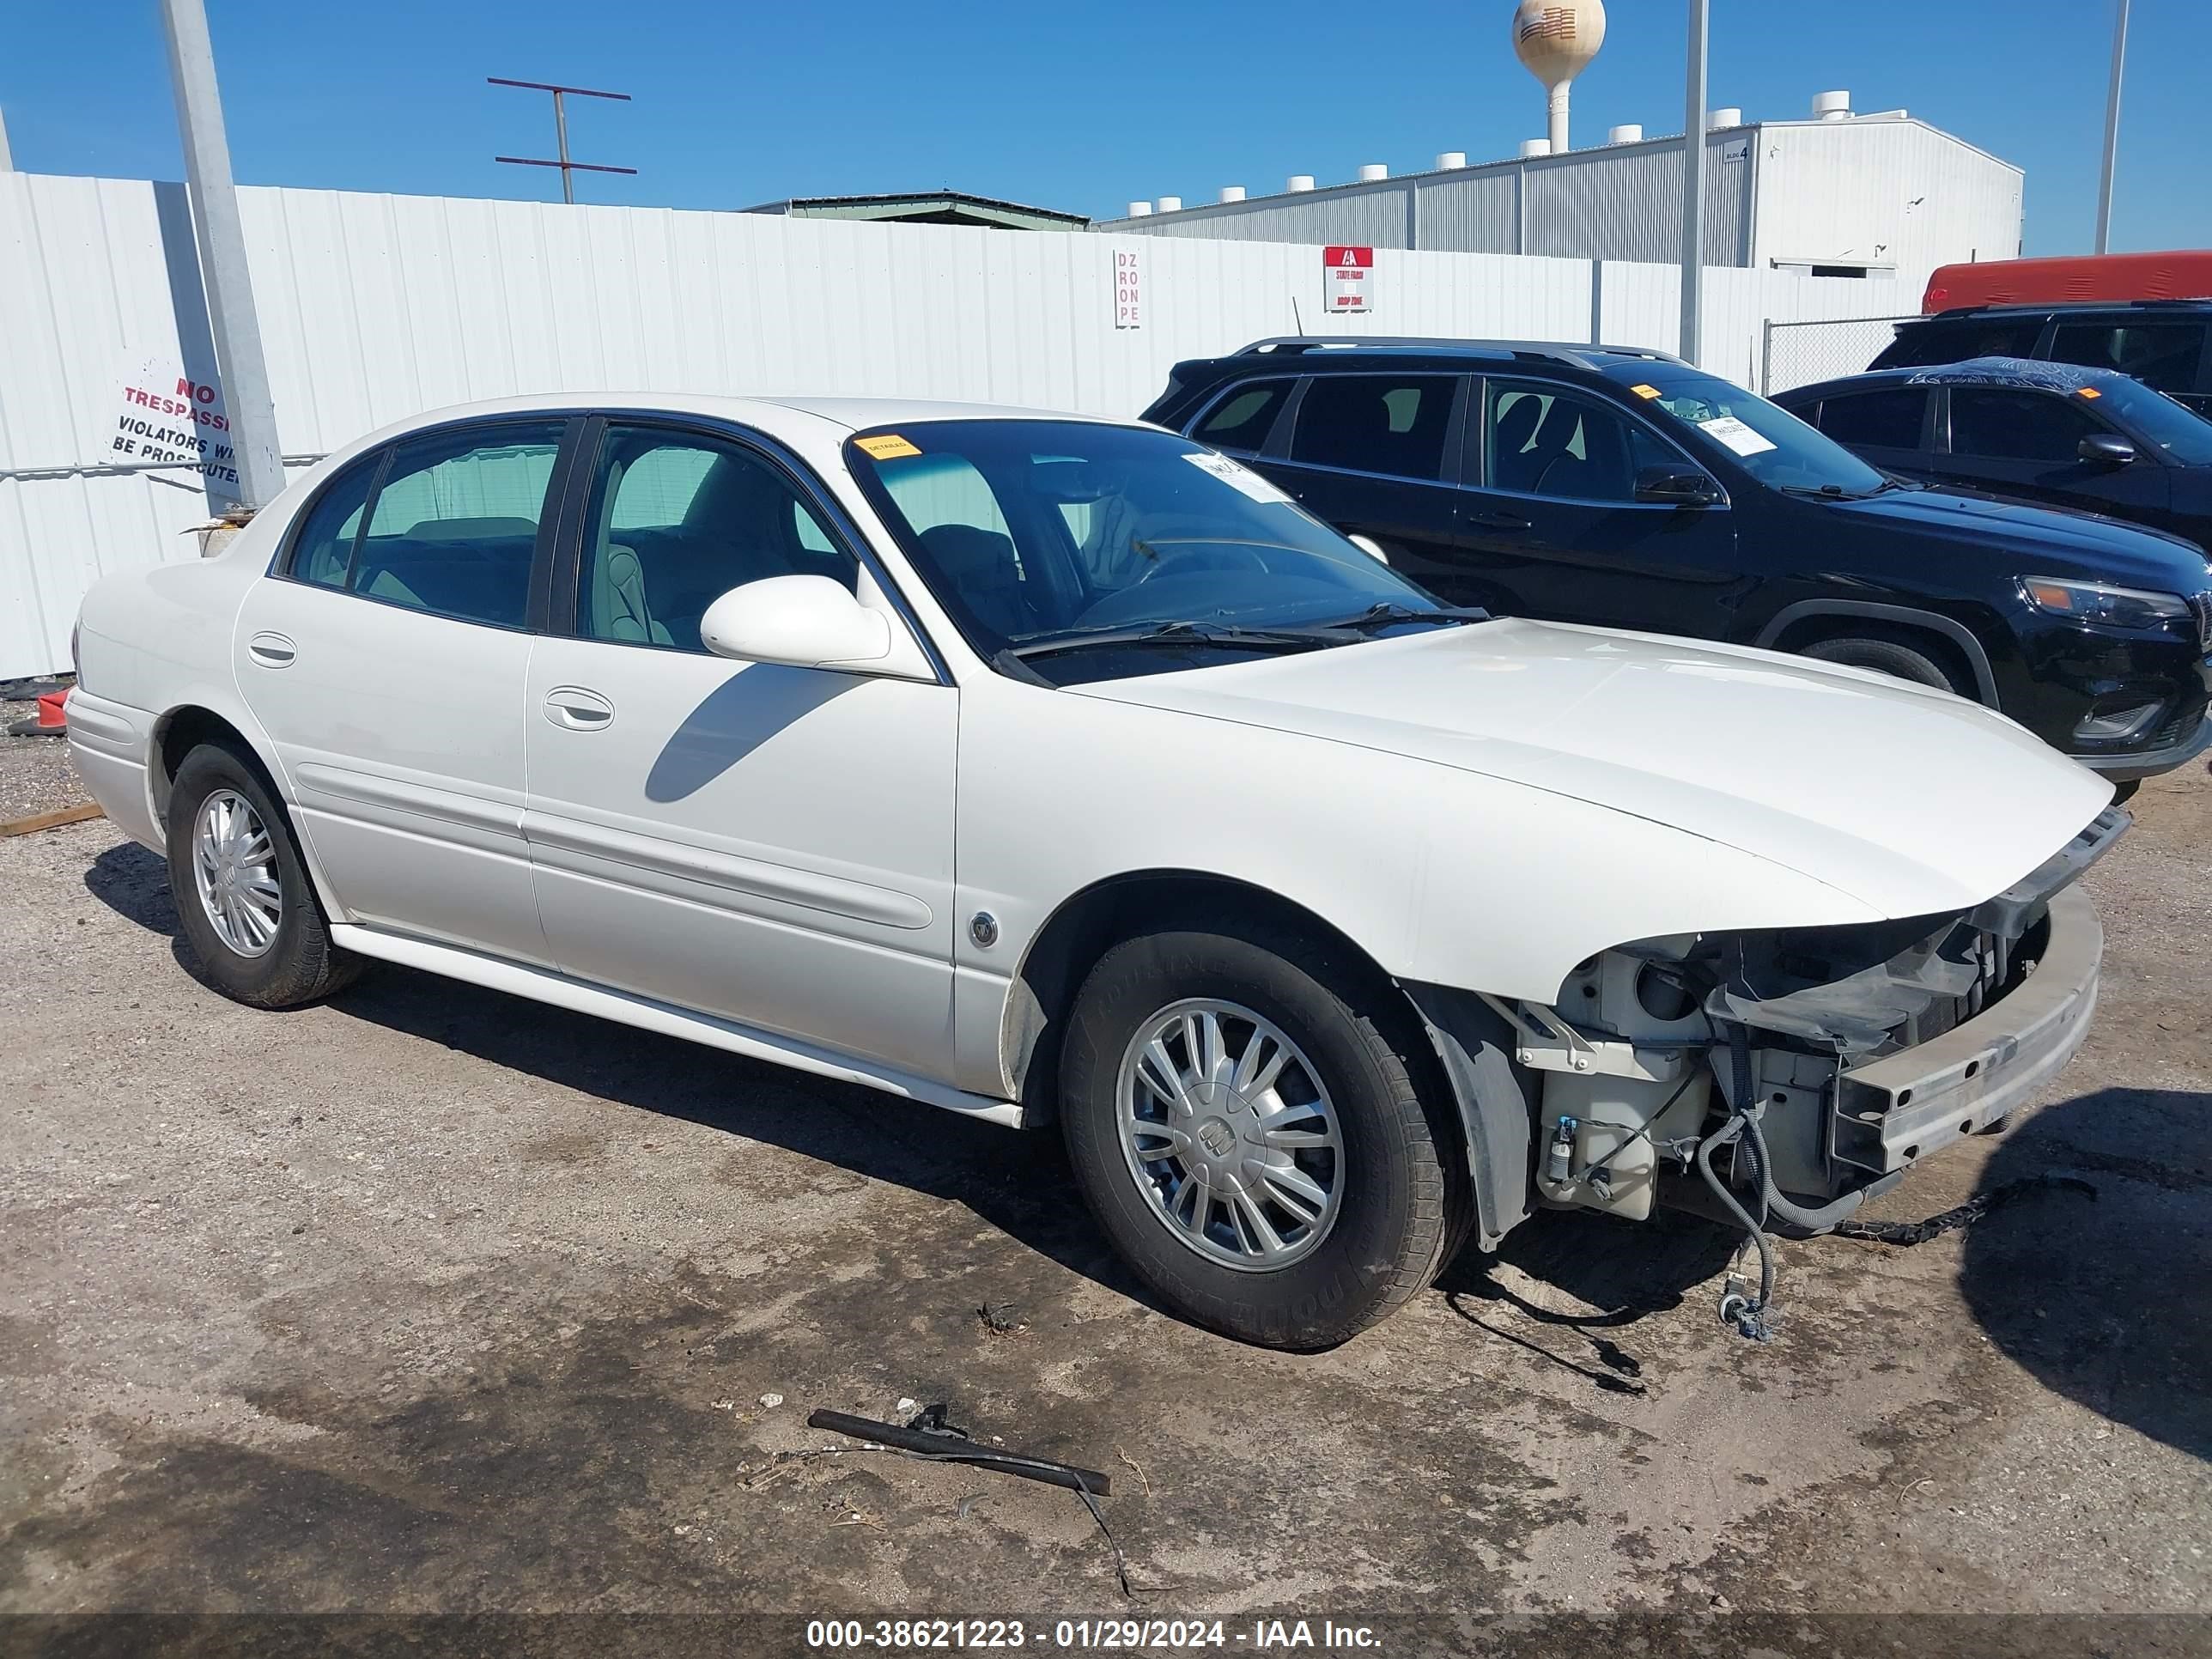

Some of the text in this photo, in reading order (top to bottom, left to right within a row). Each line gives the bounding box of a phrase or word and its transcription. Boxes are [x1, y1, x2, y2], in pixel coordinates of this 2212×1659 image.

[1741, 147, 1748, 159] 4
[1335, 270, 1351, 280] STATE
[176, 377, 216, 404] NO
[118, 415, 208, 453] VIOLATORS
[112, 435, 137, 454] BE
[215, 443, 236, 460] WI
[140, 444, 240, 484] PROSECUTE
